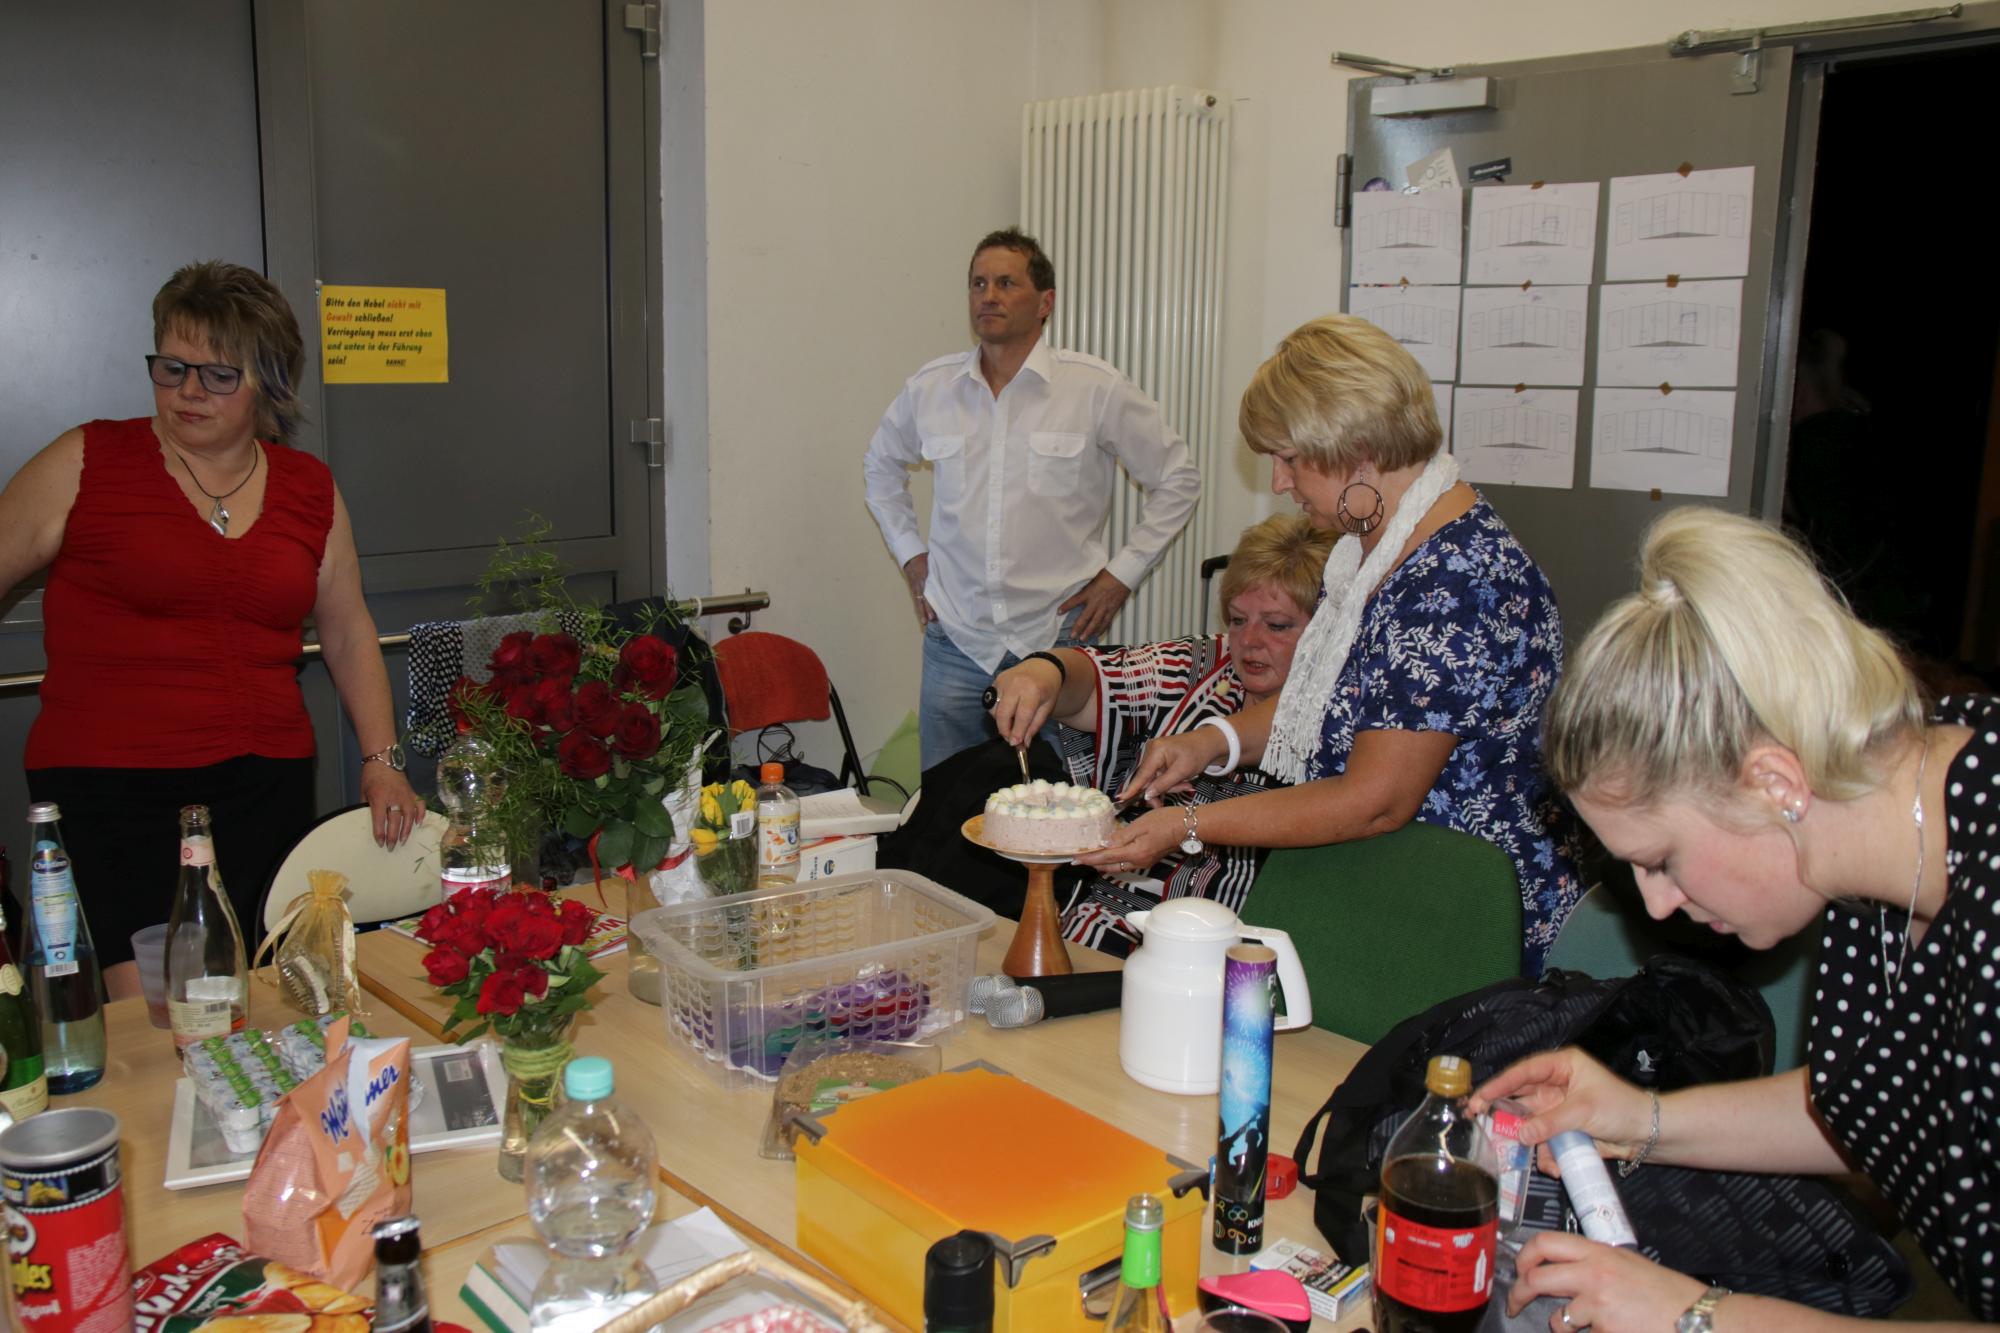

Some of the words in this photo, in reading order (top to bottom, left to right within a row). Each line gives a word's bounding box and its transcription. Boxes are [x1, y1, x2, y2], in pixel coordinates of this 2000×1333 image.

[326, 297, 345, 308] Bitte
[347, 298, 361, 308] den
[363, 298, 386, 308] Hebel
[387, 299, 407, 309] nicht
[408, 300, 422, 309] mit
[326, 312, 353, 322] Gewalt
[355, 313, 394, 323] schließen!
[327, 327, 375, 339] Verriegelung
[399, 329, 414, 337] erst
[415, 329, 433, 337] oben
[327, 341, 343, 350] und
[344, 342, 366, 351] unten
[368, 342, 376, 350] in
[377, 342, 390, 351] der
[392, 342, 423, 354] Führung
[327, 355, 347, 365] sein!
